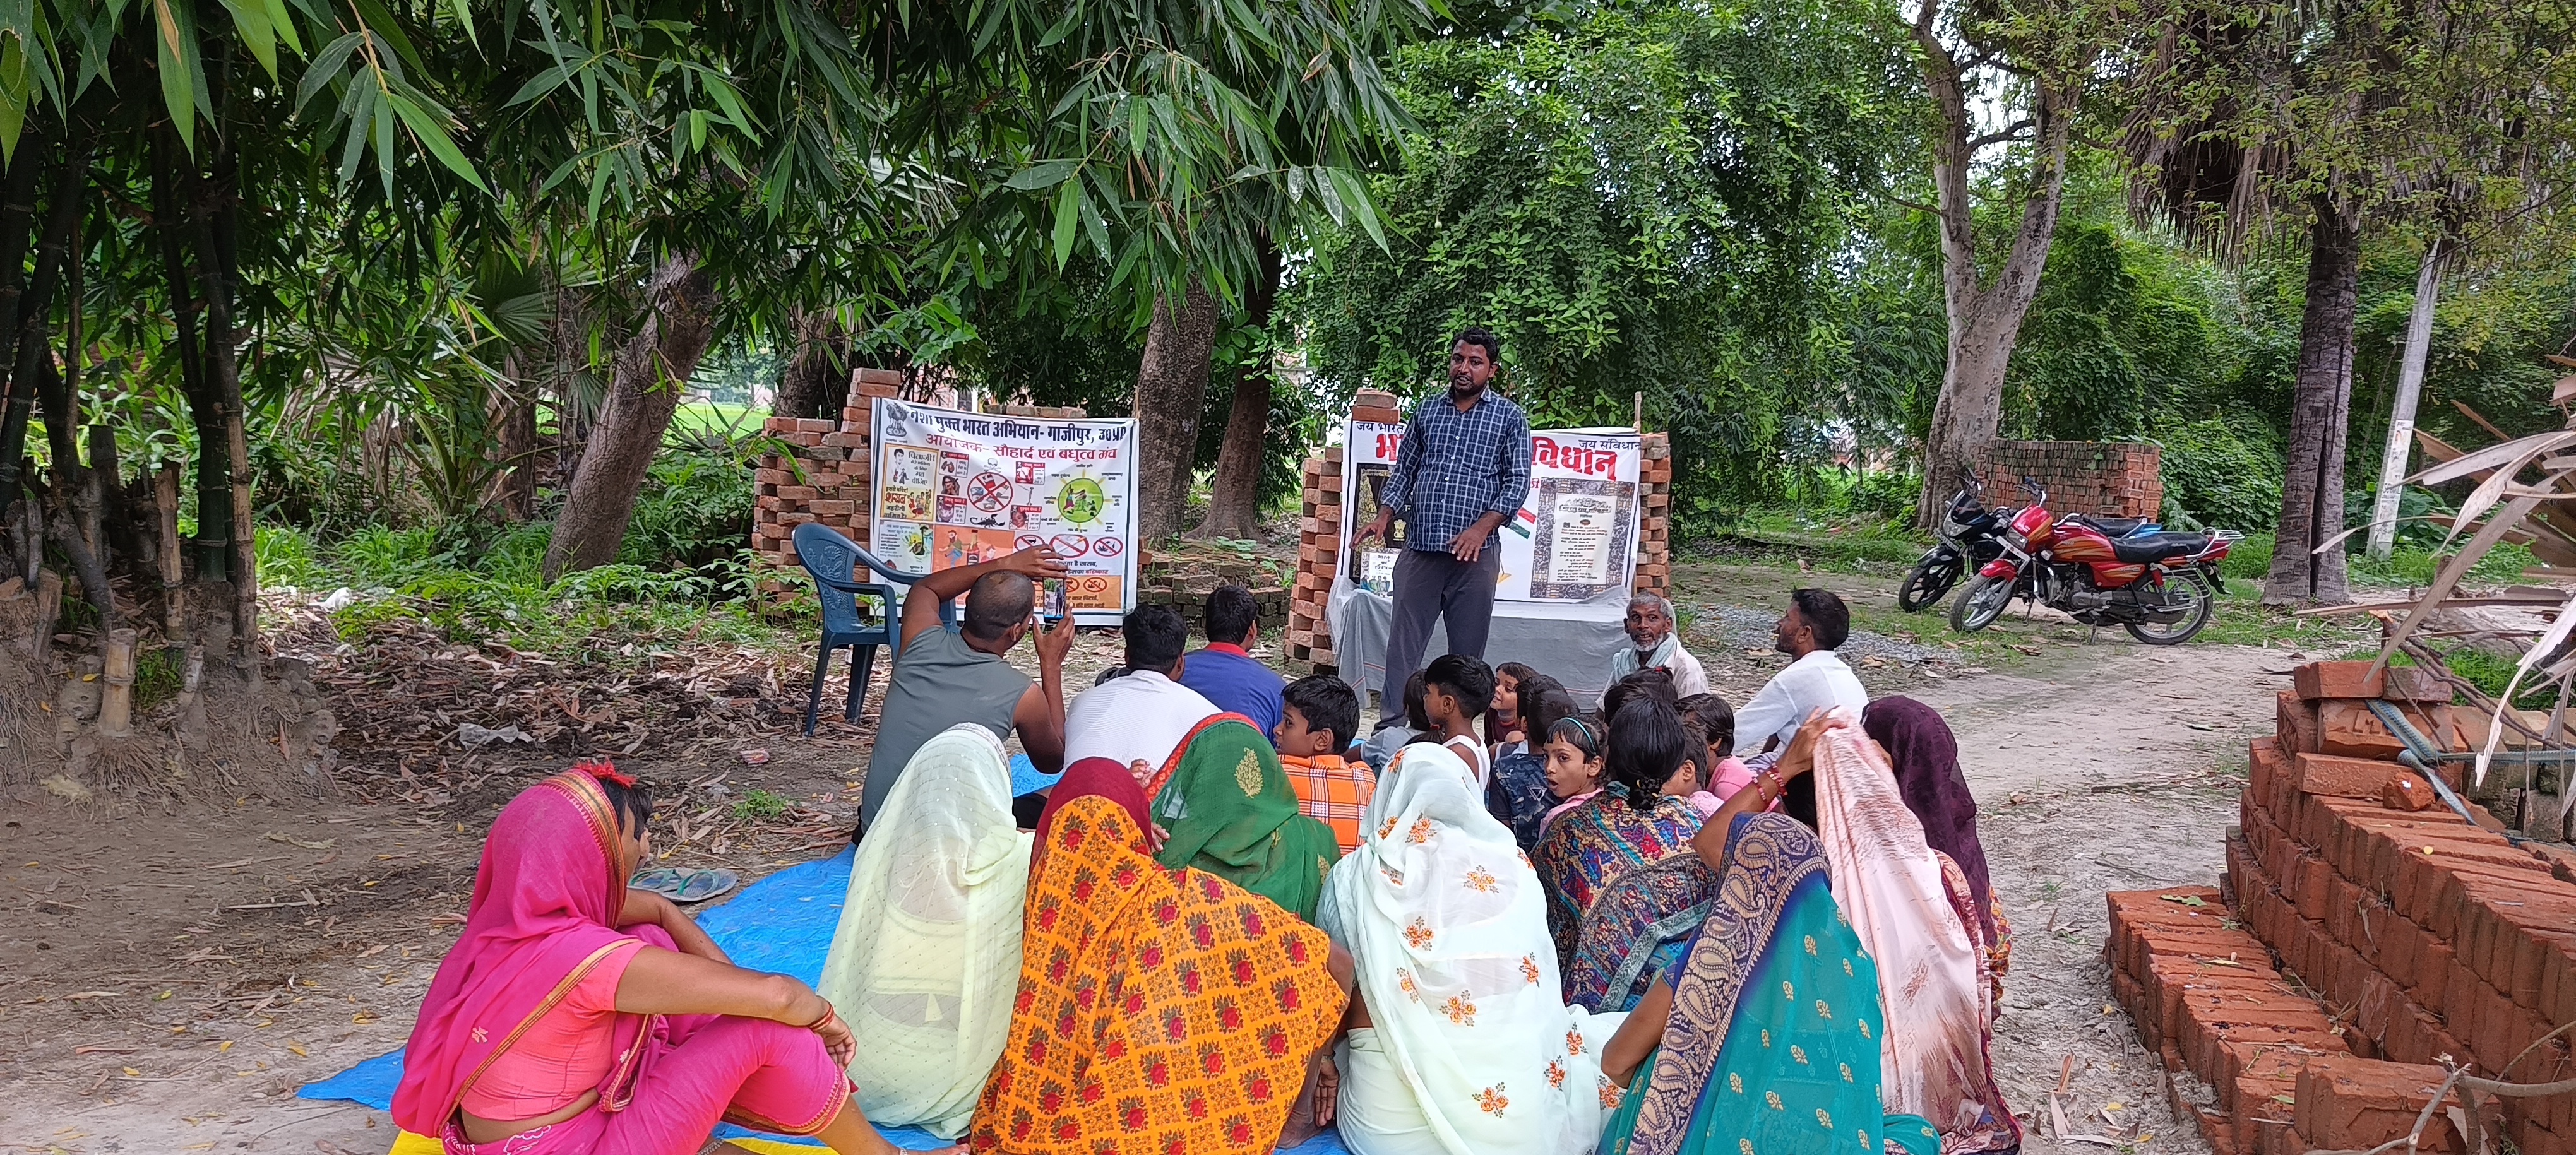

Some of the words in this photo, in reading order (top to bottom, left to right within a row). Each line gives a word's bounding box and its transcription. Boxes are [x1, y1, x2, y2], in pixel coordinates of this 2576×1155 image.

[963, 419, 991, 437] भारत
[1047, 423, 1095, 446] गाजीपुर,
[1356, 422, 1374, 432] जय
[1378, 423, 1404, 434] भारत
[993, 443, 1034, 459] सौहार्द
[1039, 446, 1055, 459] एवं
[1059, 446, 1096, 462] बंधुत्व
[1578, 439, 1598, 450] जय
[1600, 438, 1640, 451] संविधान
[909, 451, 935, 462] पिताजी!
[1532, 436, 1618, 482] विधान
